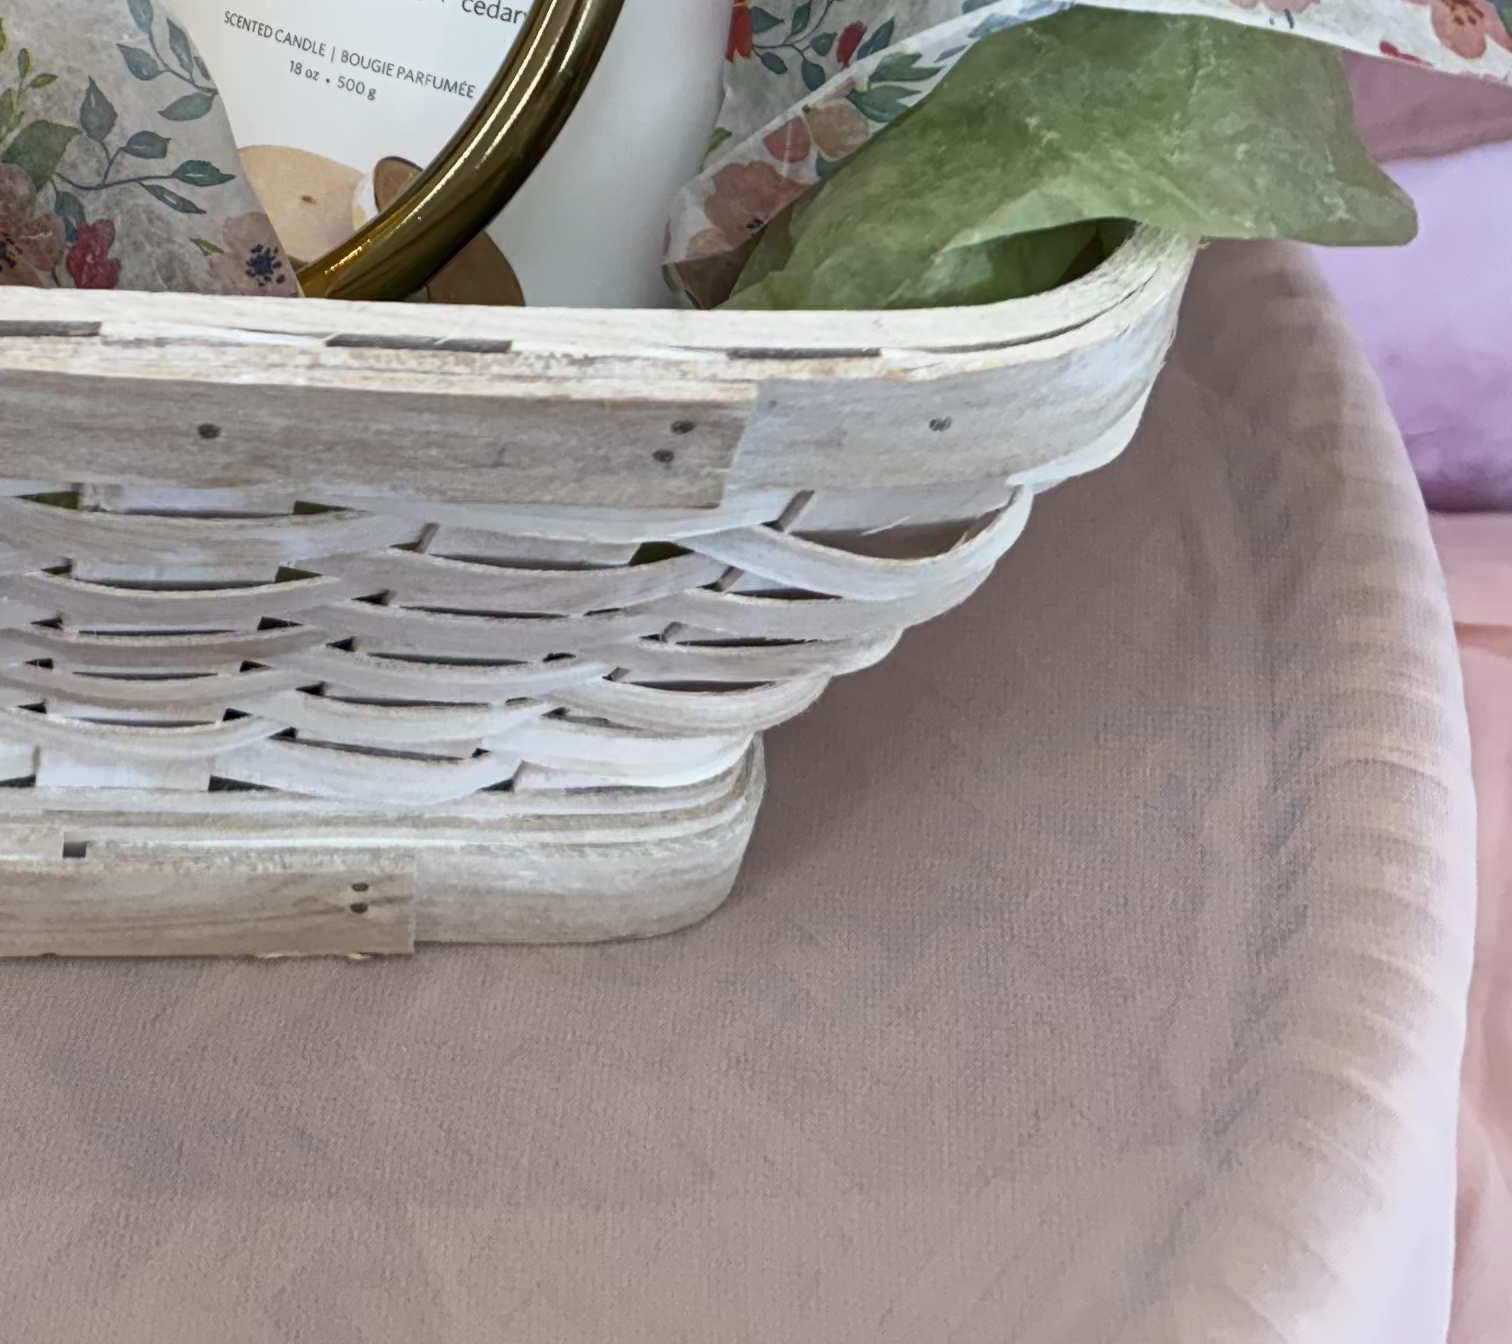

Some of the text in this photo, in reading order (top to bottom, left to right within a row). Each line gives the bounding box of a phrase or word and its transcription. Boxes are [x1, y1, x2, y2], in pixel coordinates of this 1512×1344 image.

[224, 10, 273, 39] SCENTED
[274, 28, 327, 57] CANDLE
[340, 49, 395, 78] BOUGIE
[396, 65, 476, 100] PARFUMÉE
[289, 60, 304, 76] 18
[304, 67, 321, 82] oz
[337, 75, 366, 96] 500
